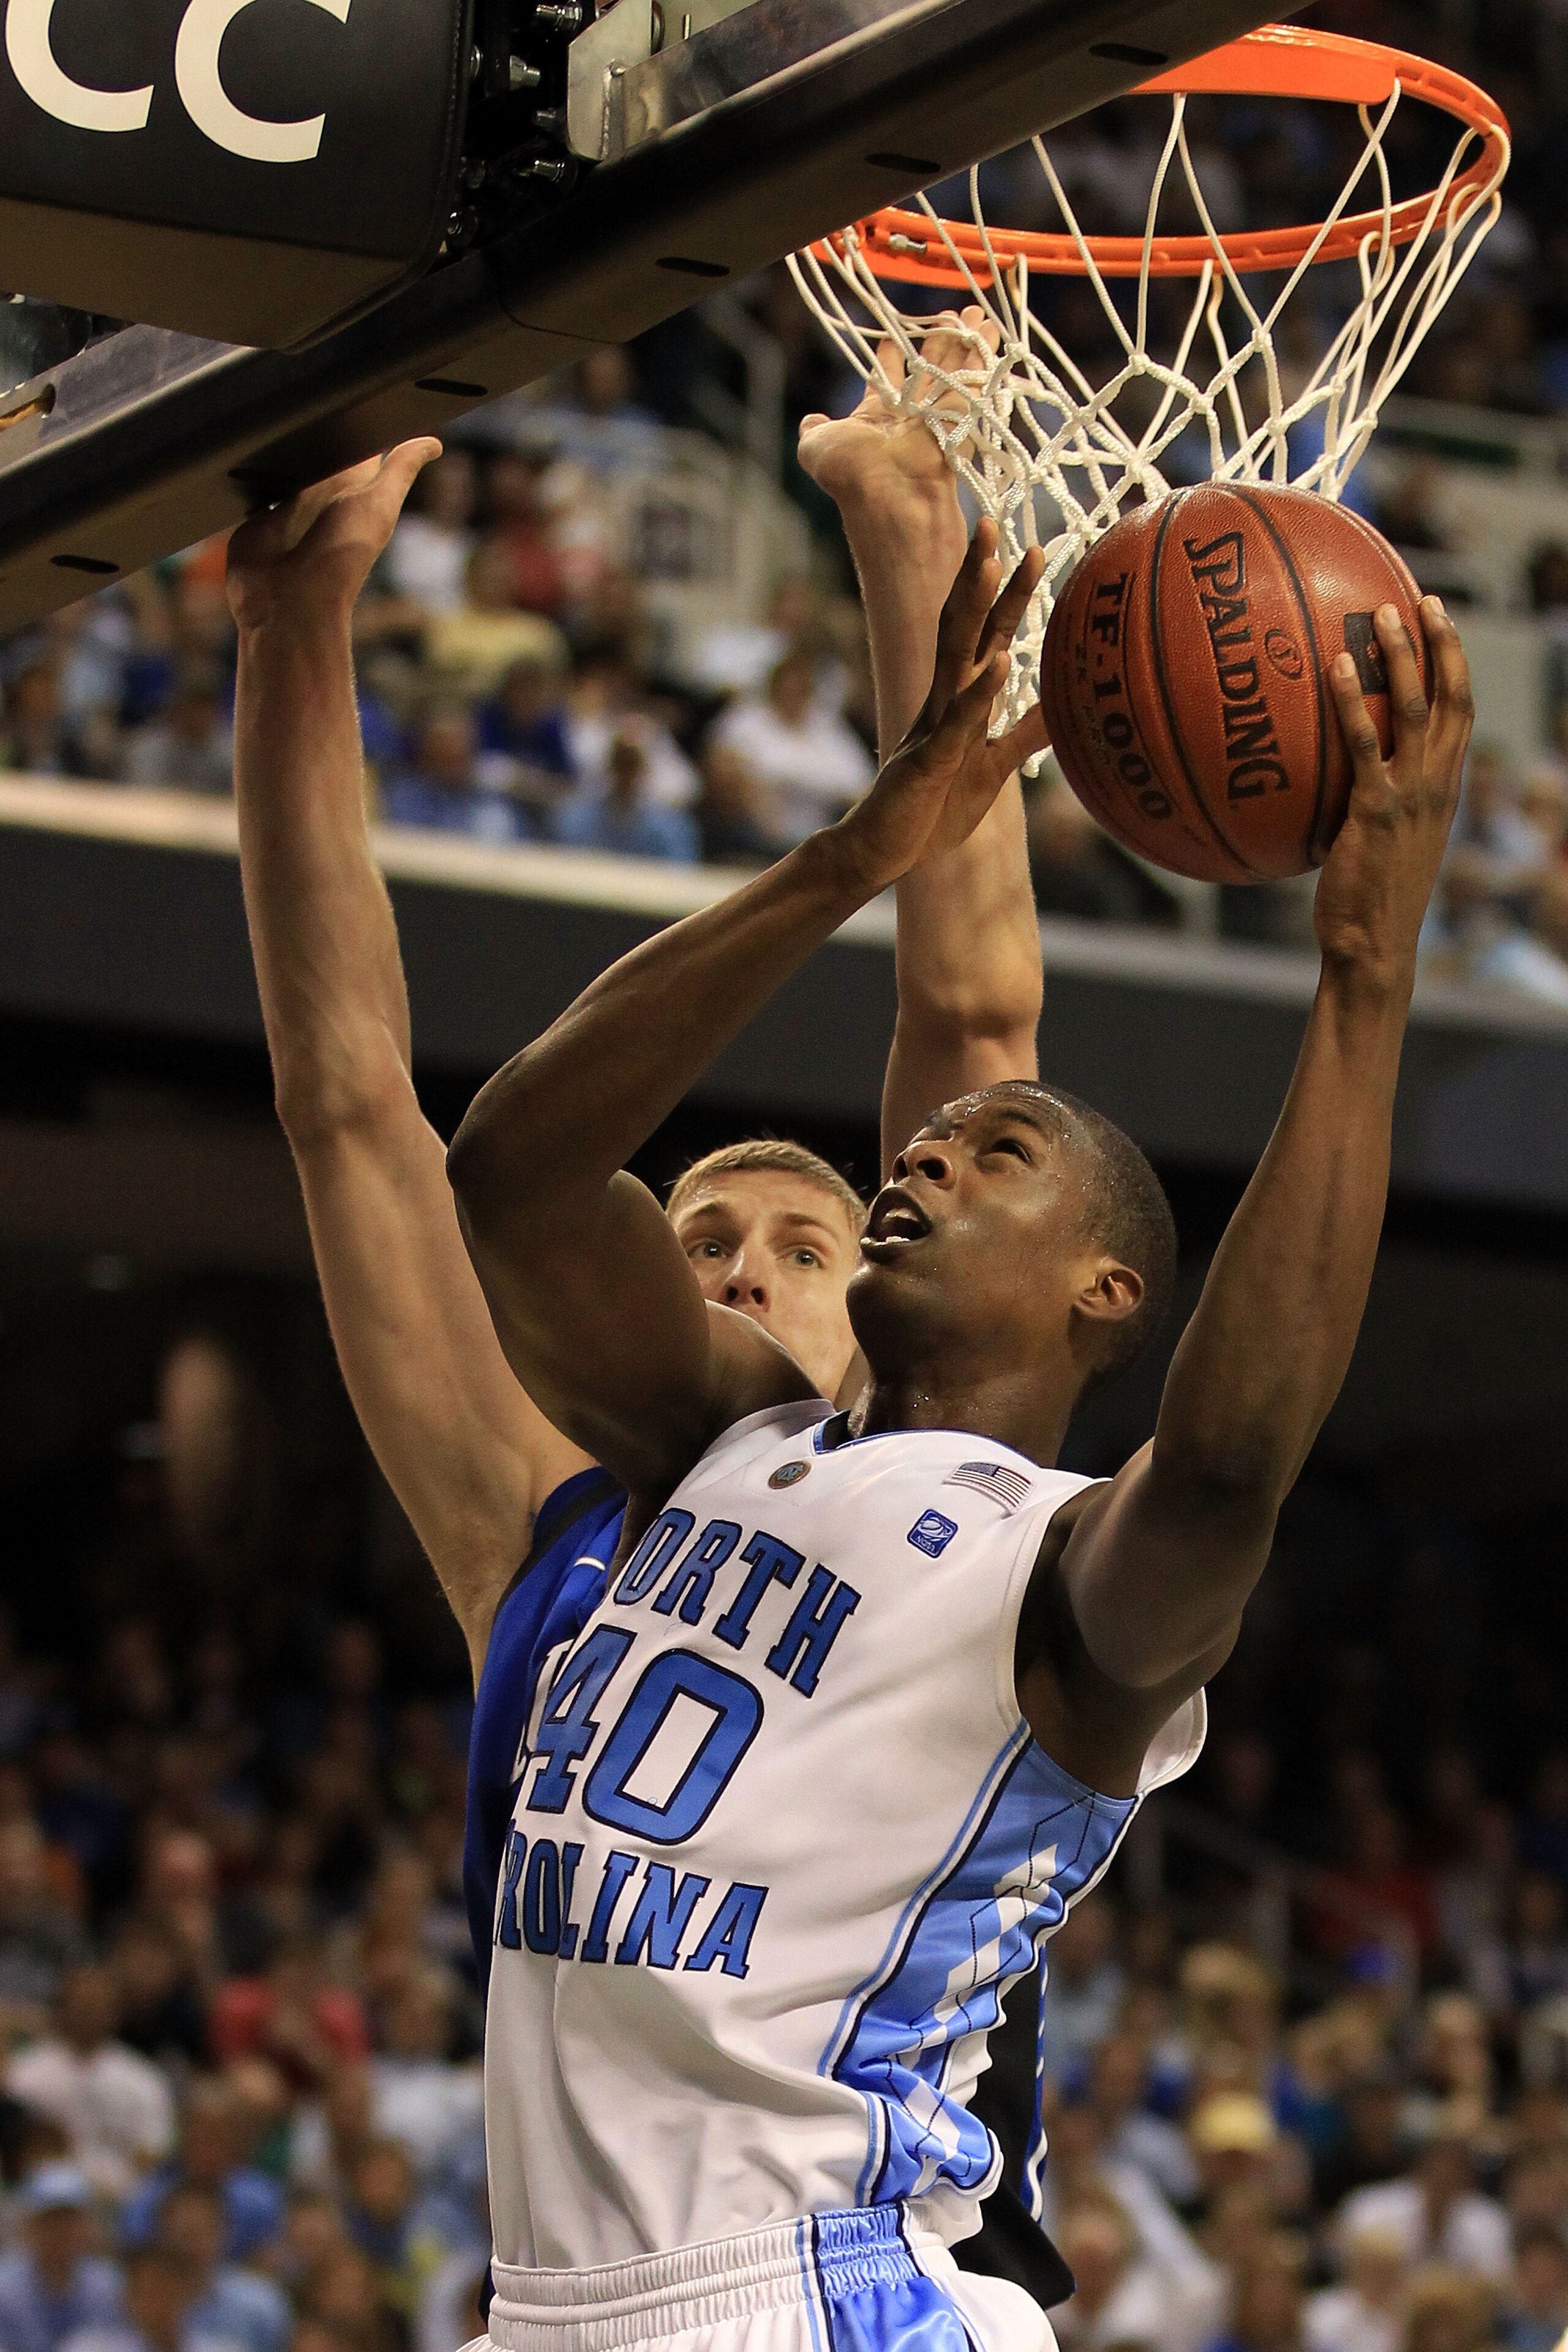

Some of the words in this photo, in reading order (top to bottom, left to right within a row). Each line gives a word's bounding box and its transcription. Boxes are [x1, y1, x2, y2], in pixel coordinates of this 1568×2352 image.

[5, 0, 352, 163] CC
[1091, 572, 1173, 820] TF-1000
[1183, 530, 1290, 800] SPALDING
[612, 1507, 862, 1698] ORTH
[526, 1623, 764, 1845] 40
[492, 1818, 769, 1980] ROLINA
